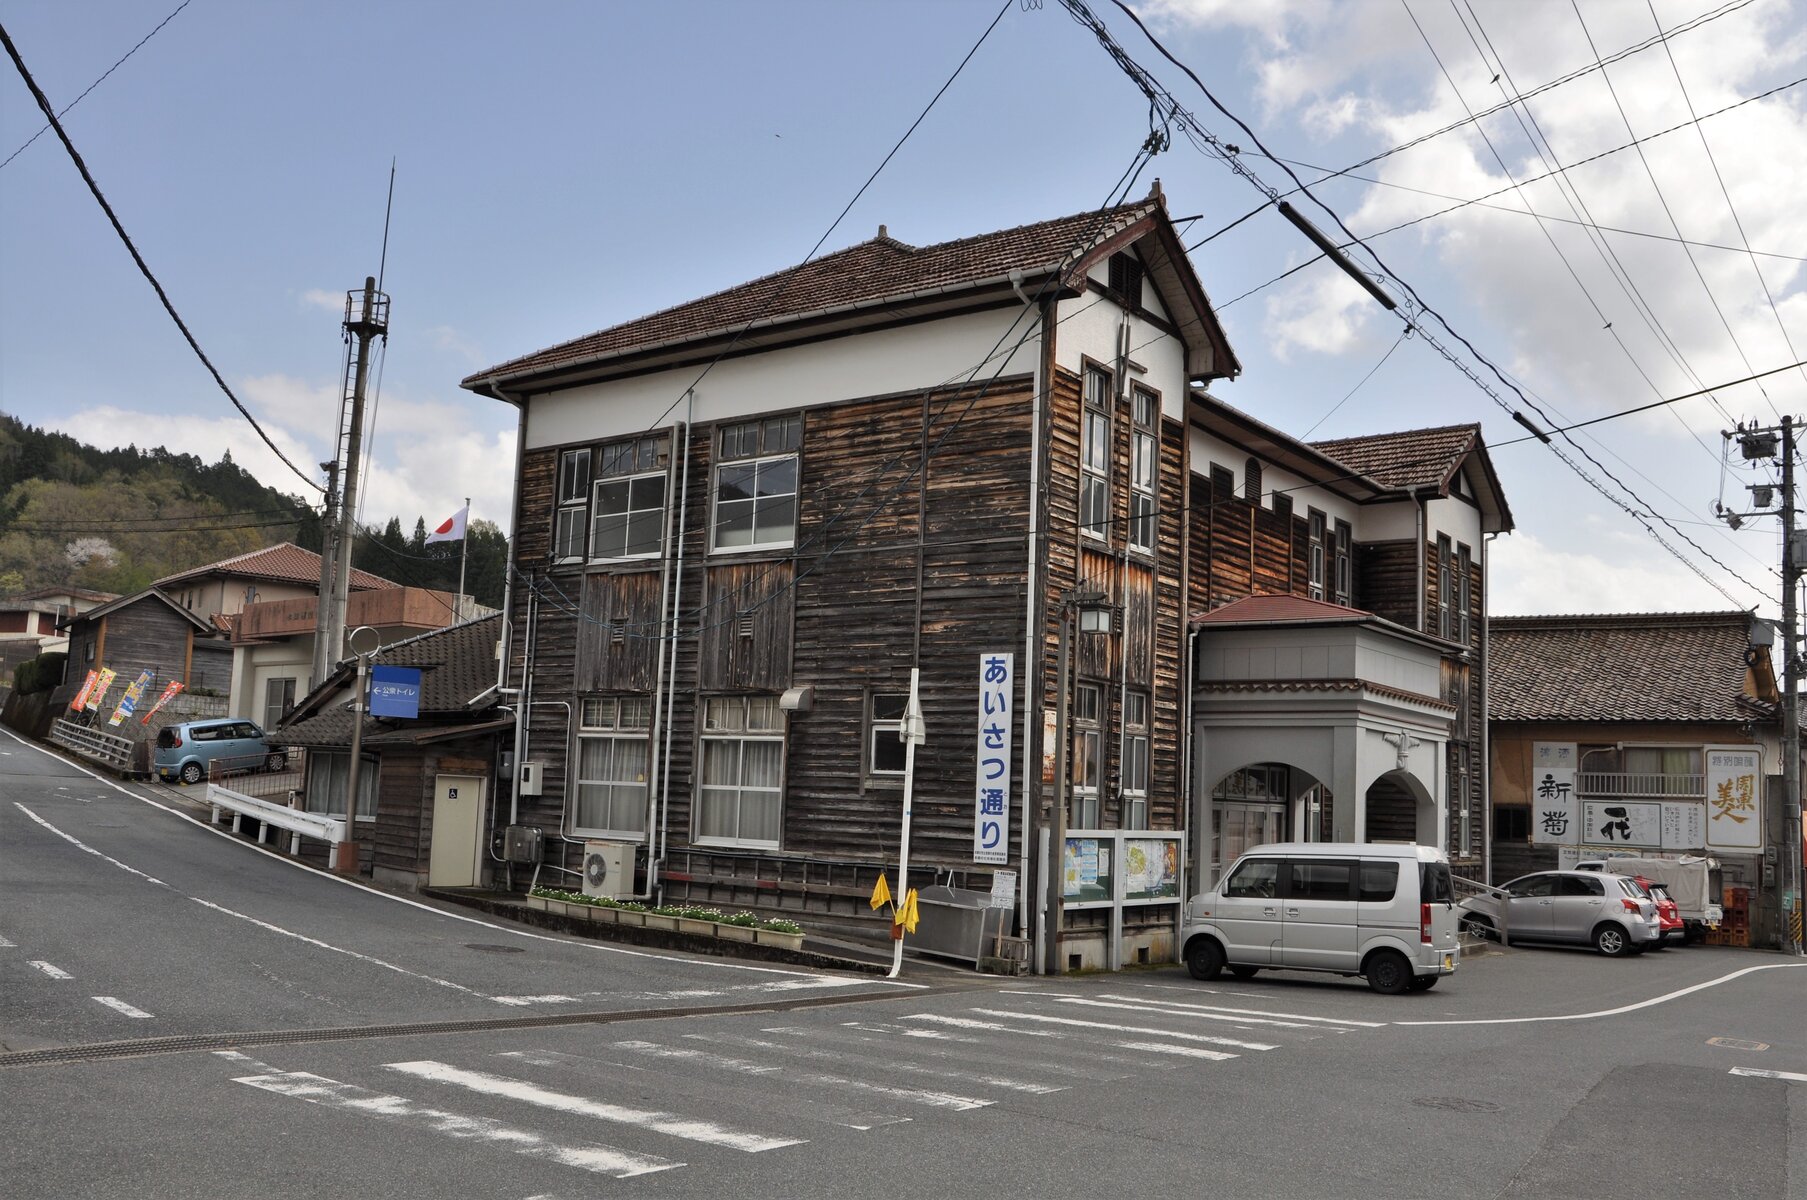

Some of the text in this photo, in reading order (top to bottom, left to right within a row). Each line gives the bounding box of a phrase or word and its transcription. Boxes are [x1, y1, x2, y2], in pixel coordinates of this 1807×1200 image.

[382, 686, 415, 696] 公衆トイレ
[980, 656, 1007, 849] あいさつ通り
[1537, 774, 1572, 836] 新菊
